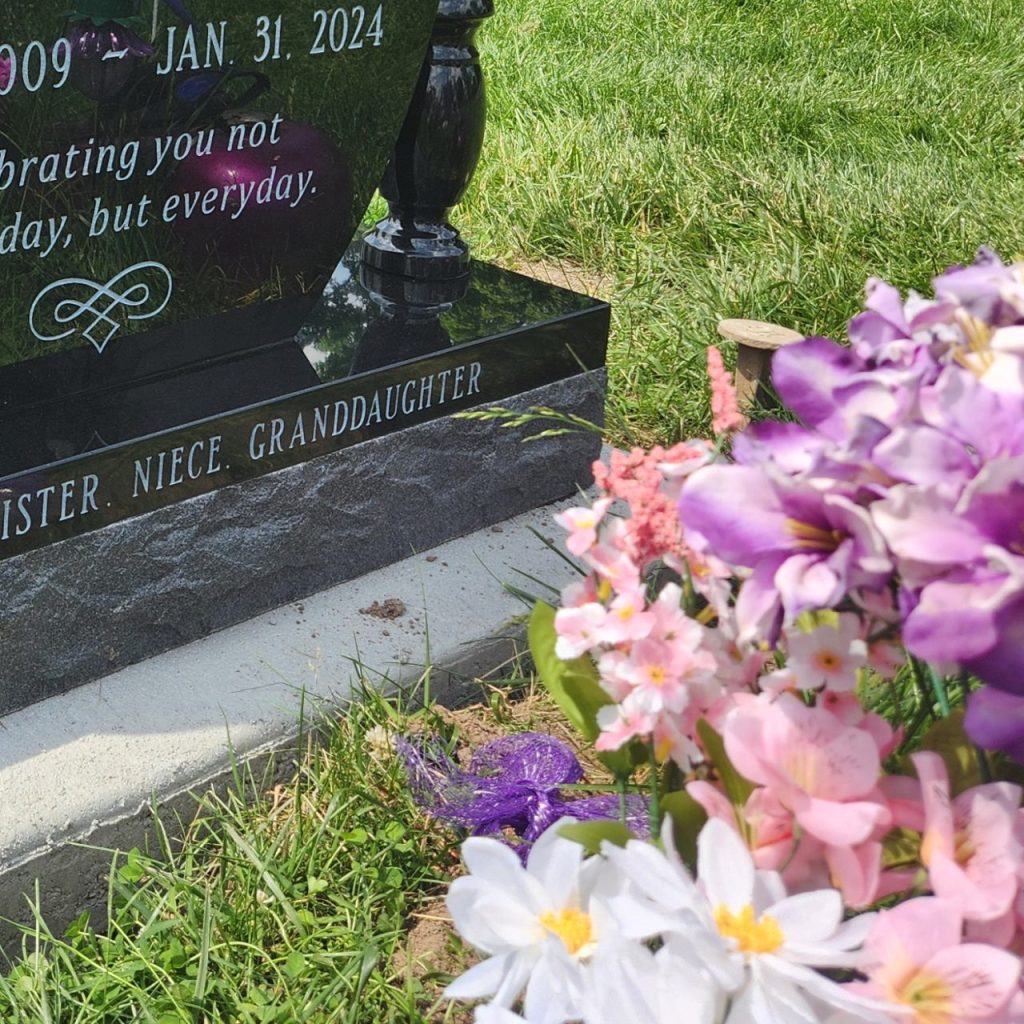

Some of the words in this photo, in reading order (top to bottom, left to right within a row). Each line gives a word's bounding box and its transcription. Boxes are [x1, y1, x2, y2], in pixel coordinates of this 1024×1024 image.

[156, 20, 235, 75] JAN.
[253, 14, 293, 63] 31,
[309, 3, 385, 55] 2024
[147, 129, 216, 176] you
[226, 112, 284, 151] not
[88, 193, 153, 238] but
[161, 165, 318, 224] everyday.
[248, 360, 483, 461] GRANDDAUGHTER
